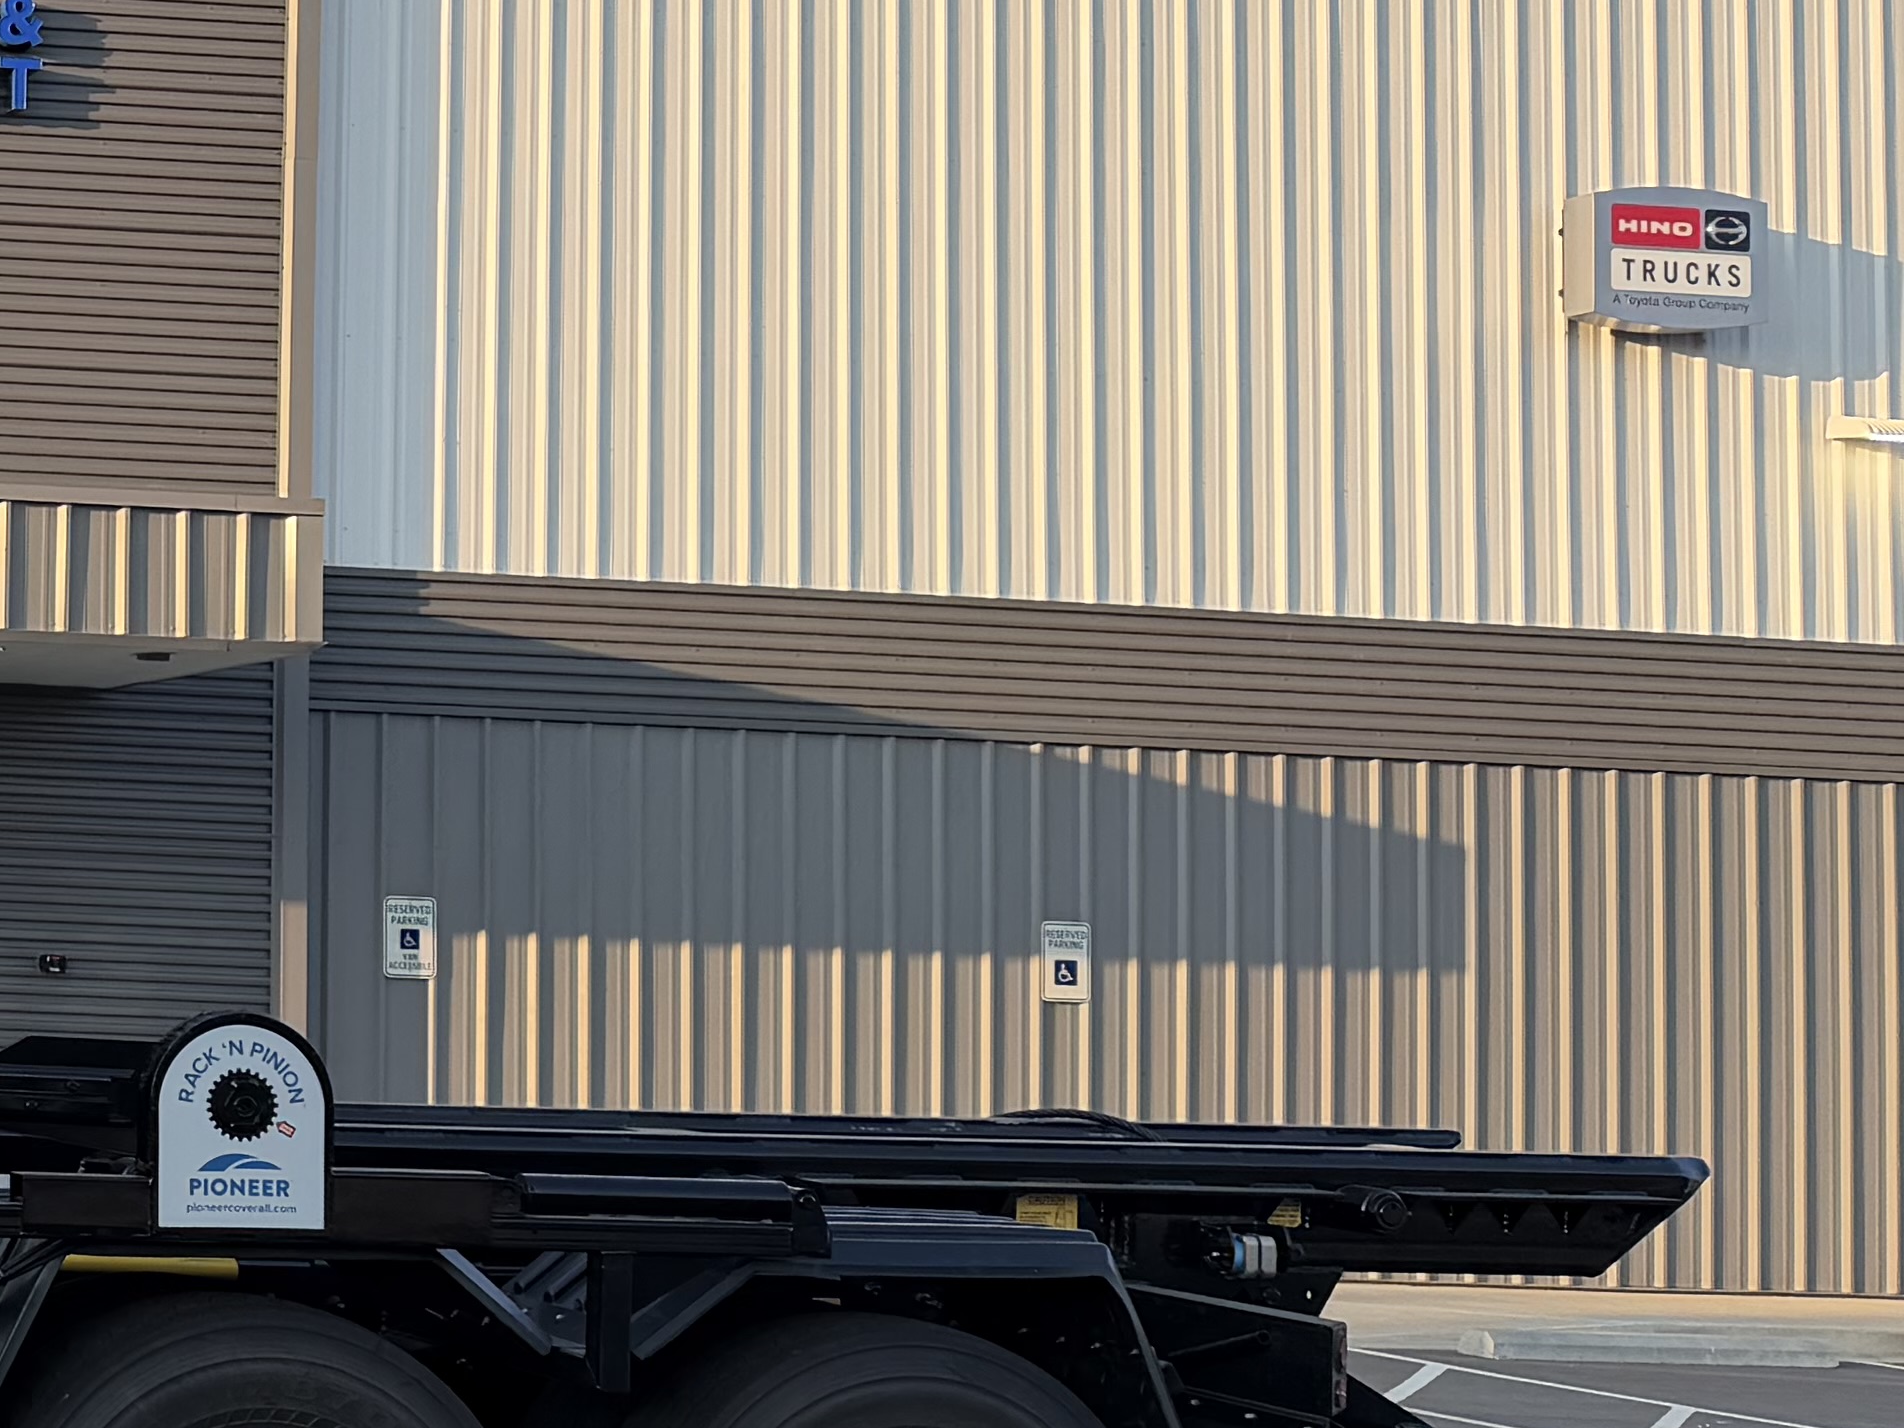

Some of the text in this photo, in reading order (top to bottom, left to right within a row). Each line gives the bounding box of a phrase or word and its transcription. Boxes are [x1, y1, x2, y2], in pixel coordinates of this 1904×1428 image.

[1618, 218, 1693, 237] HINO
[1622, 257, 1741, 288] TRUCKS
[1613, 294, 1750, 314] A Toyota Group Company
[386, 904, 432, 915] RESERVED
[390, 915, 429, 926] PARKING
[1046, 929, 1088, 940] RESERVED
[1048, 939, 1084, 950] PARKING
[178, 1046, 220, 1103] RACK
[249, 1041, 305, 1105] PINION
[189, 1178, 291, 1198] PIONEER
[186, 1202, 297, 1214] pioneercoverall.com
